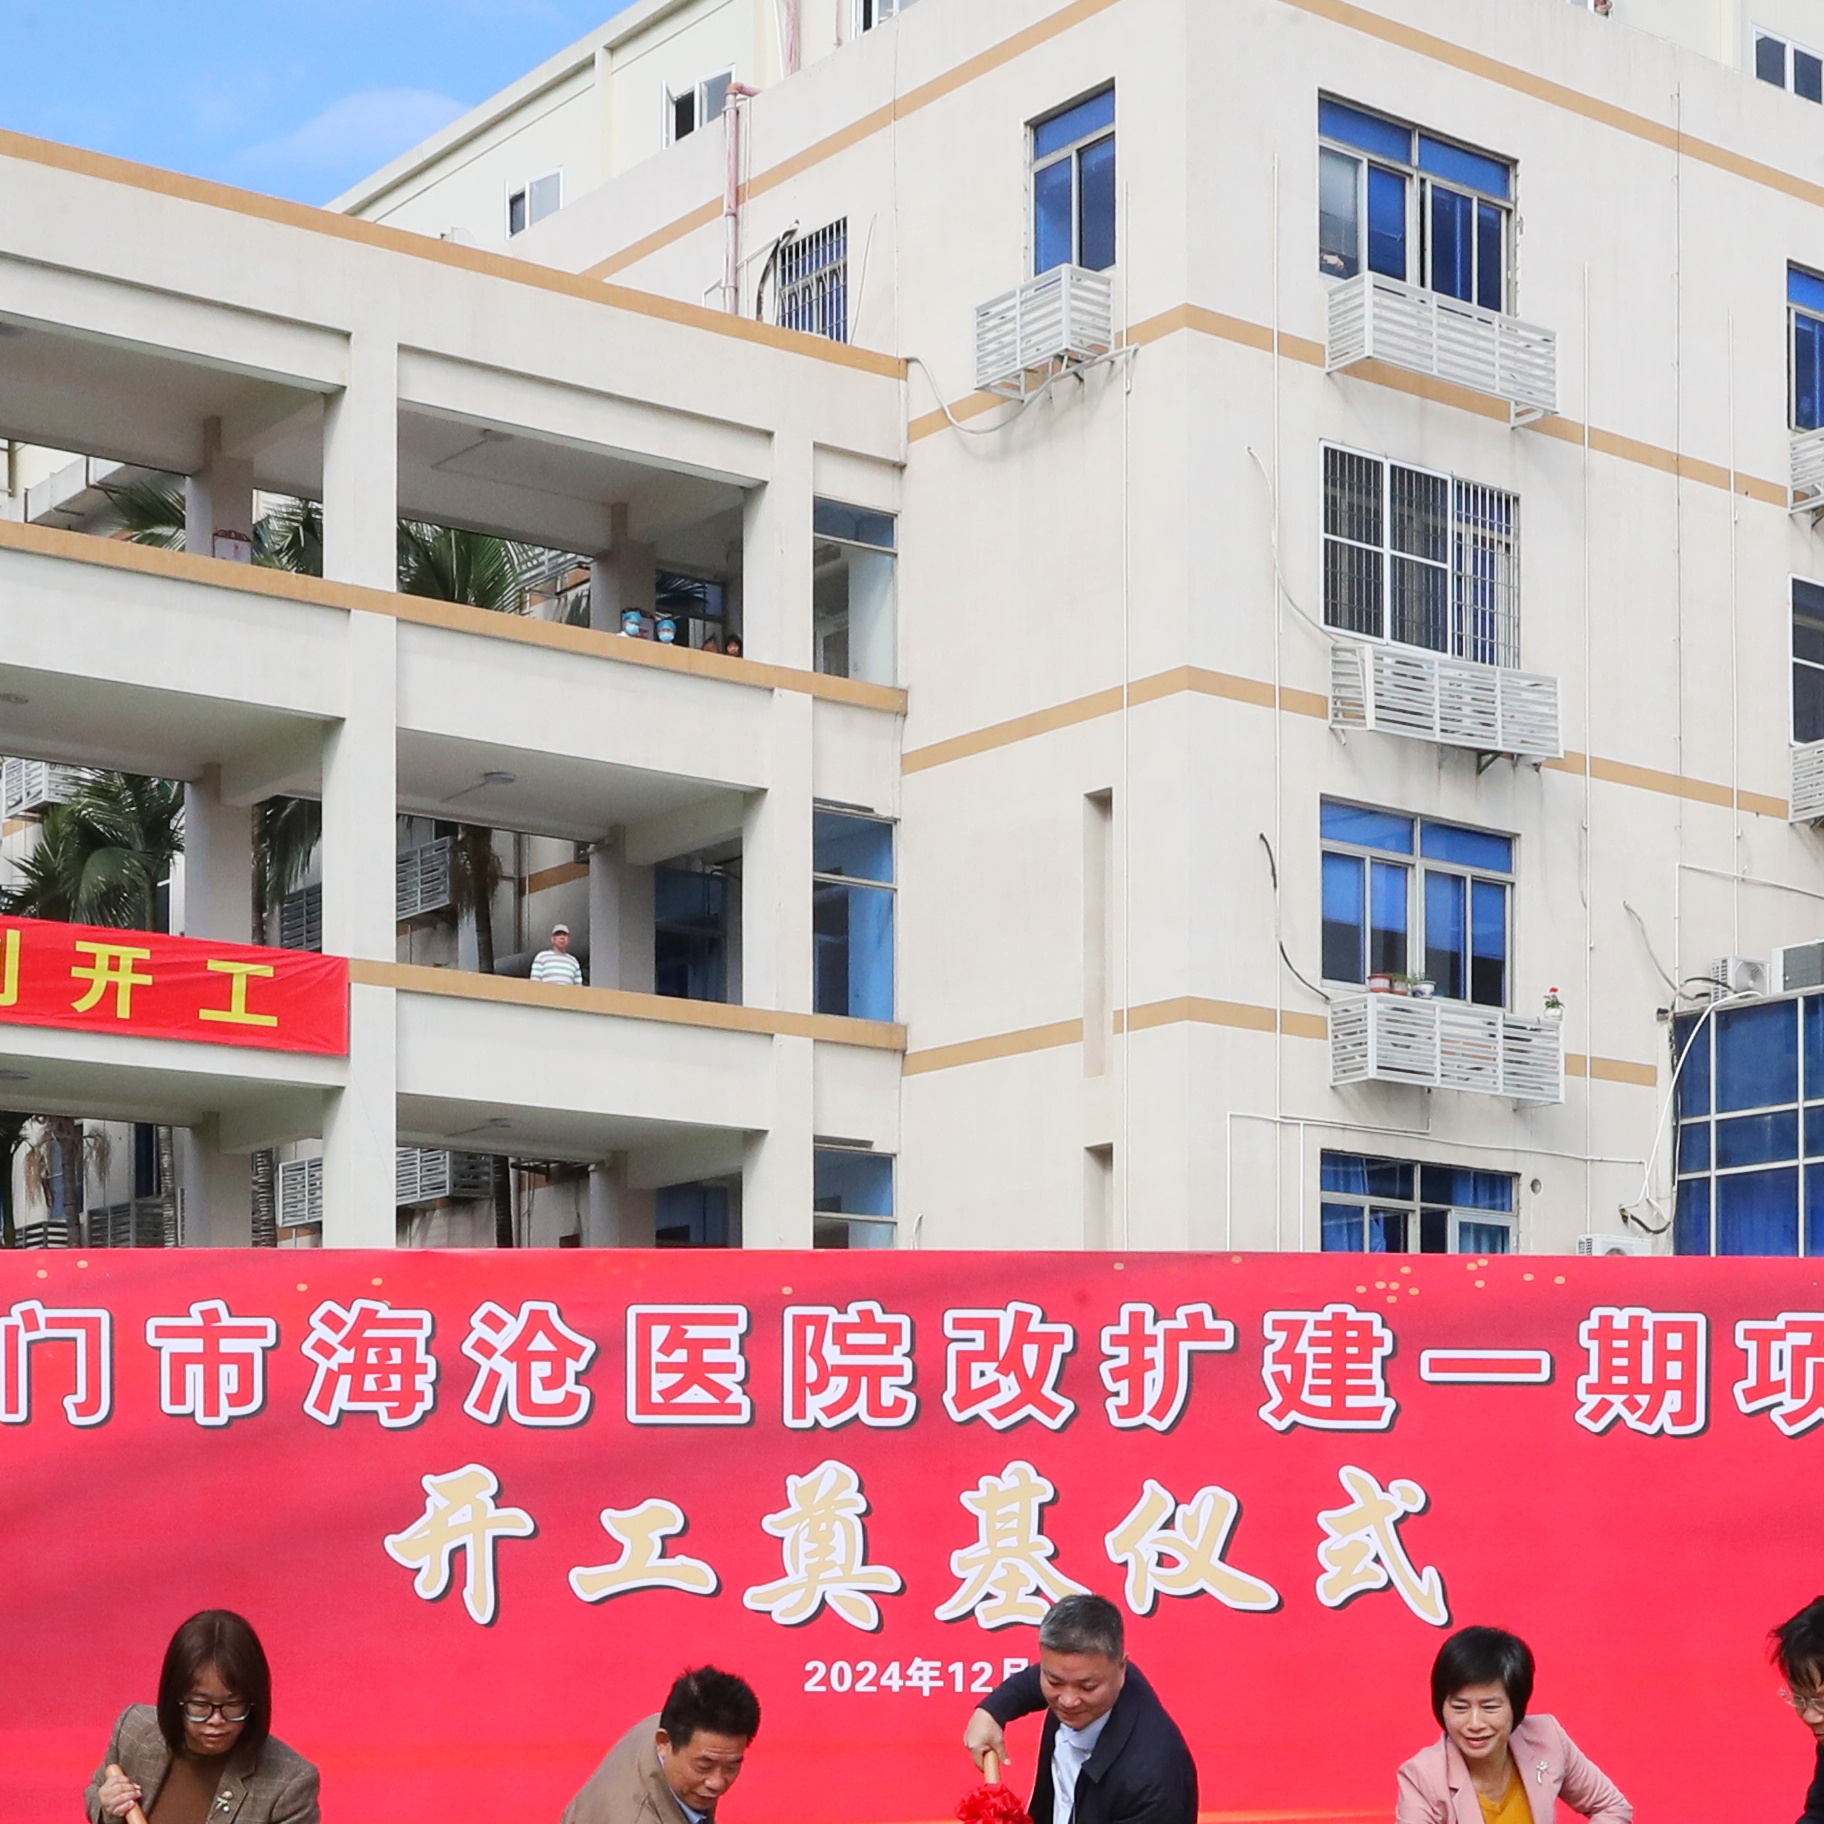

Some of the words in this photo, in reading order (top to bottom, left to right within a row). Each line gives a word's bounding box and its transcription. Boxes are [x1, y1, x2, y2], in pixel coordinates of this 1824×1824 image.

[383, 1459, 1453, 1631] 开工奠基仪式
